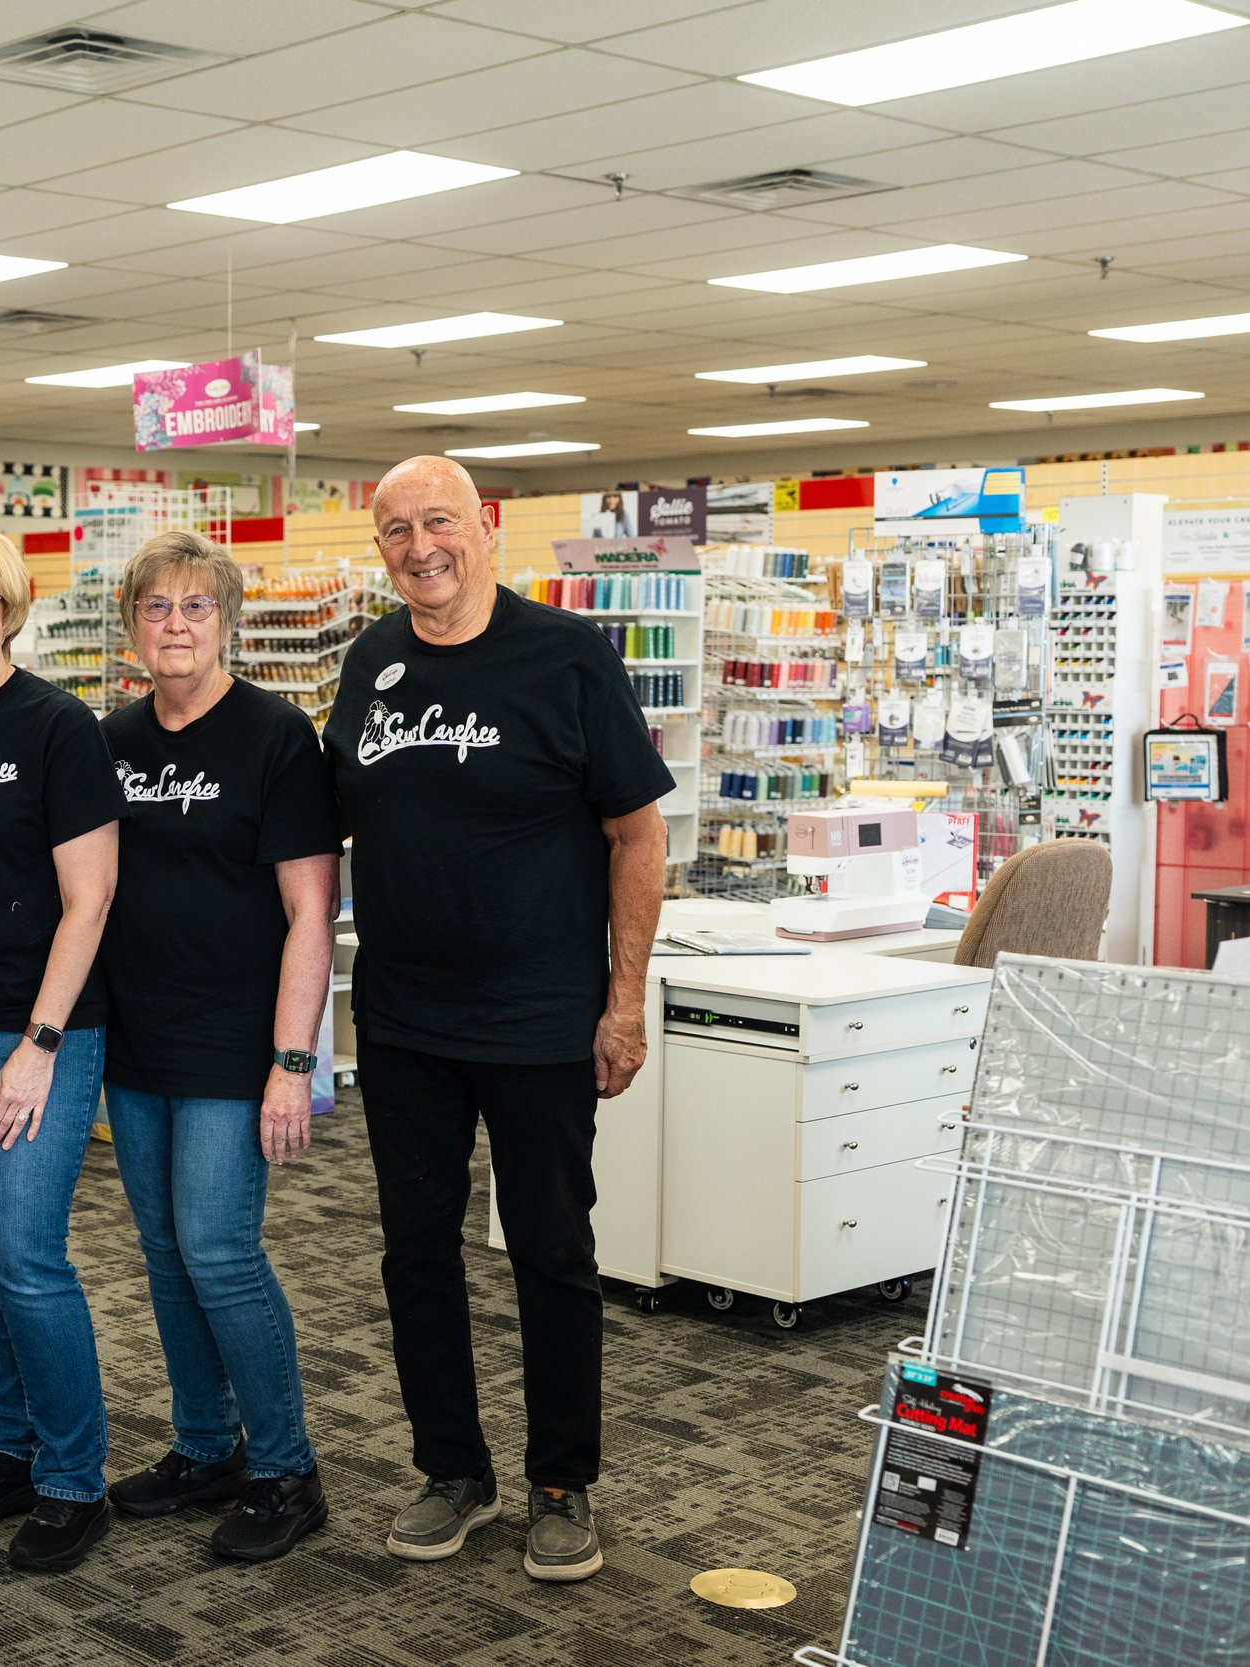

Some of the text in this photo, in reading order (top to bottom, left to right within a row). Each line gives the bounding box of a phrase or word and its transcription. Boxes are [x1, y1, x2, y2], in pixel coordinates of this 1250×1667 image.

[650, 497, 694, 521] Sallie
[655, 515, 691, 526] TOMATO
[595, 548, 659, 563] MADEIRA
[381, 704, 500, 763] Sew Carefree
[124, 764, 220, 815] Sew Carefree
[948, 817, 972, 827] PFAFF
[896, 1402, 978, 1437] Cutting Mat
